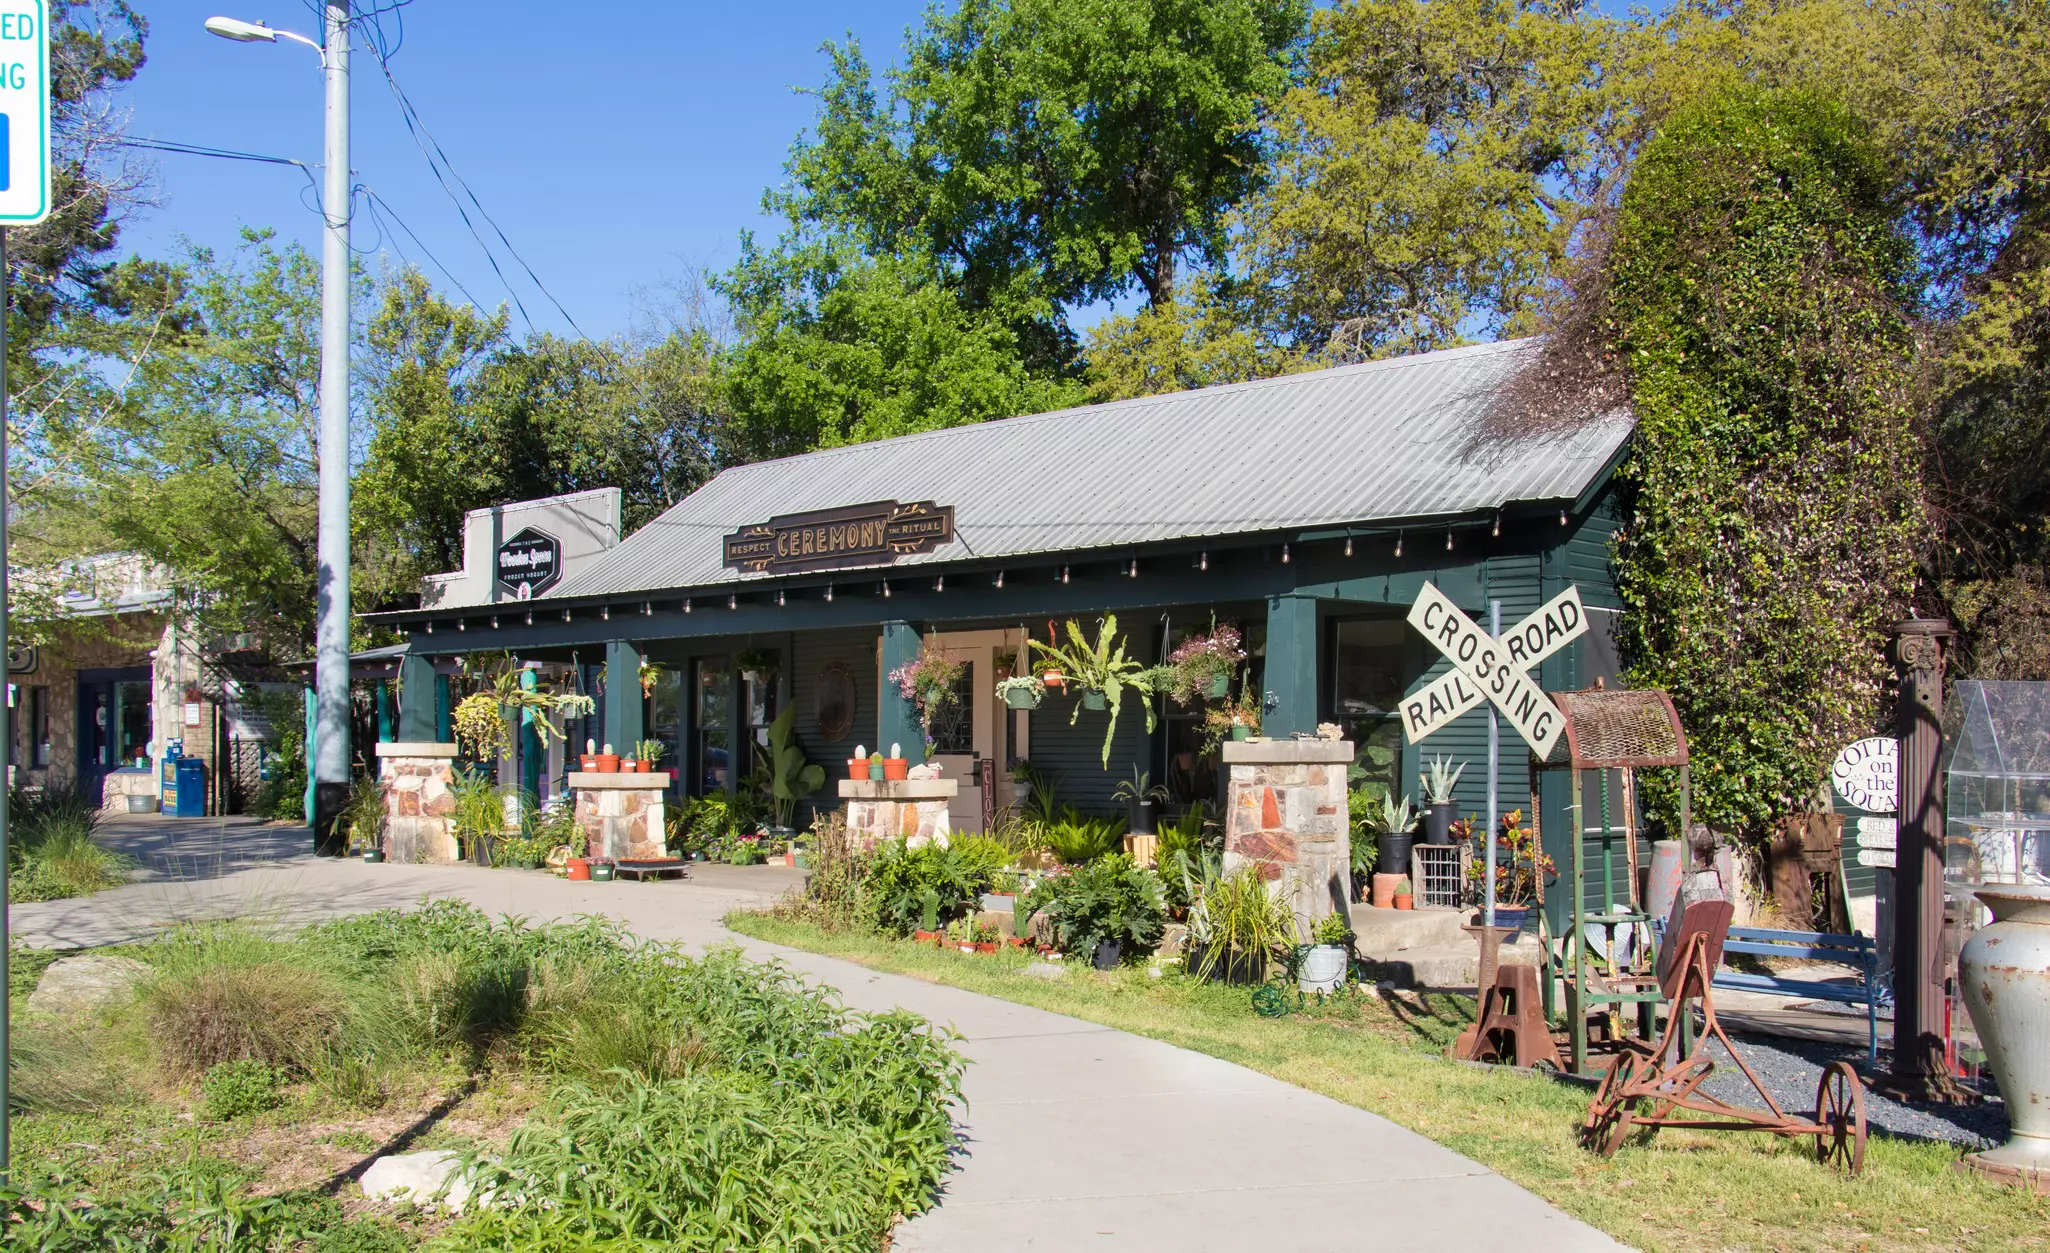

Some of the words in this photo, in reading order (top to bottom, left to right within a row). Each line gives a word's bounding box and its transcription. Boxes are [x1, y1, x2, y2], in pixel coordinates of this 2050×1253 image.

[2, 13, 34, 40] ED
[902, 522, 941, 533] RITUAL
[732, 543, 770, 554] RESPECT
[778, 520, 887, 557] CEREMONY
[527, 570, 547, 578] YOGURT
[1407, 676, 1475, 732] RAIL
[1507, 600, 1579, 664] ROAD
[1424, 601, 1552, 742] CROSSING
[1870, 761, 1893, 773] on
[1867, 775, 1894, 790] the
[984, 770, 993, 828] CLOS
[1838, 781, 1897, 811] SQUA
[1867, 820, 1885, 831] BED
